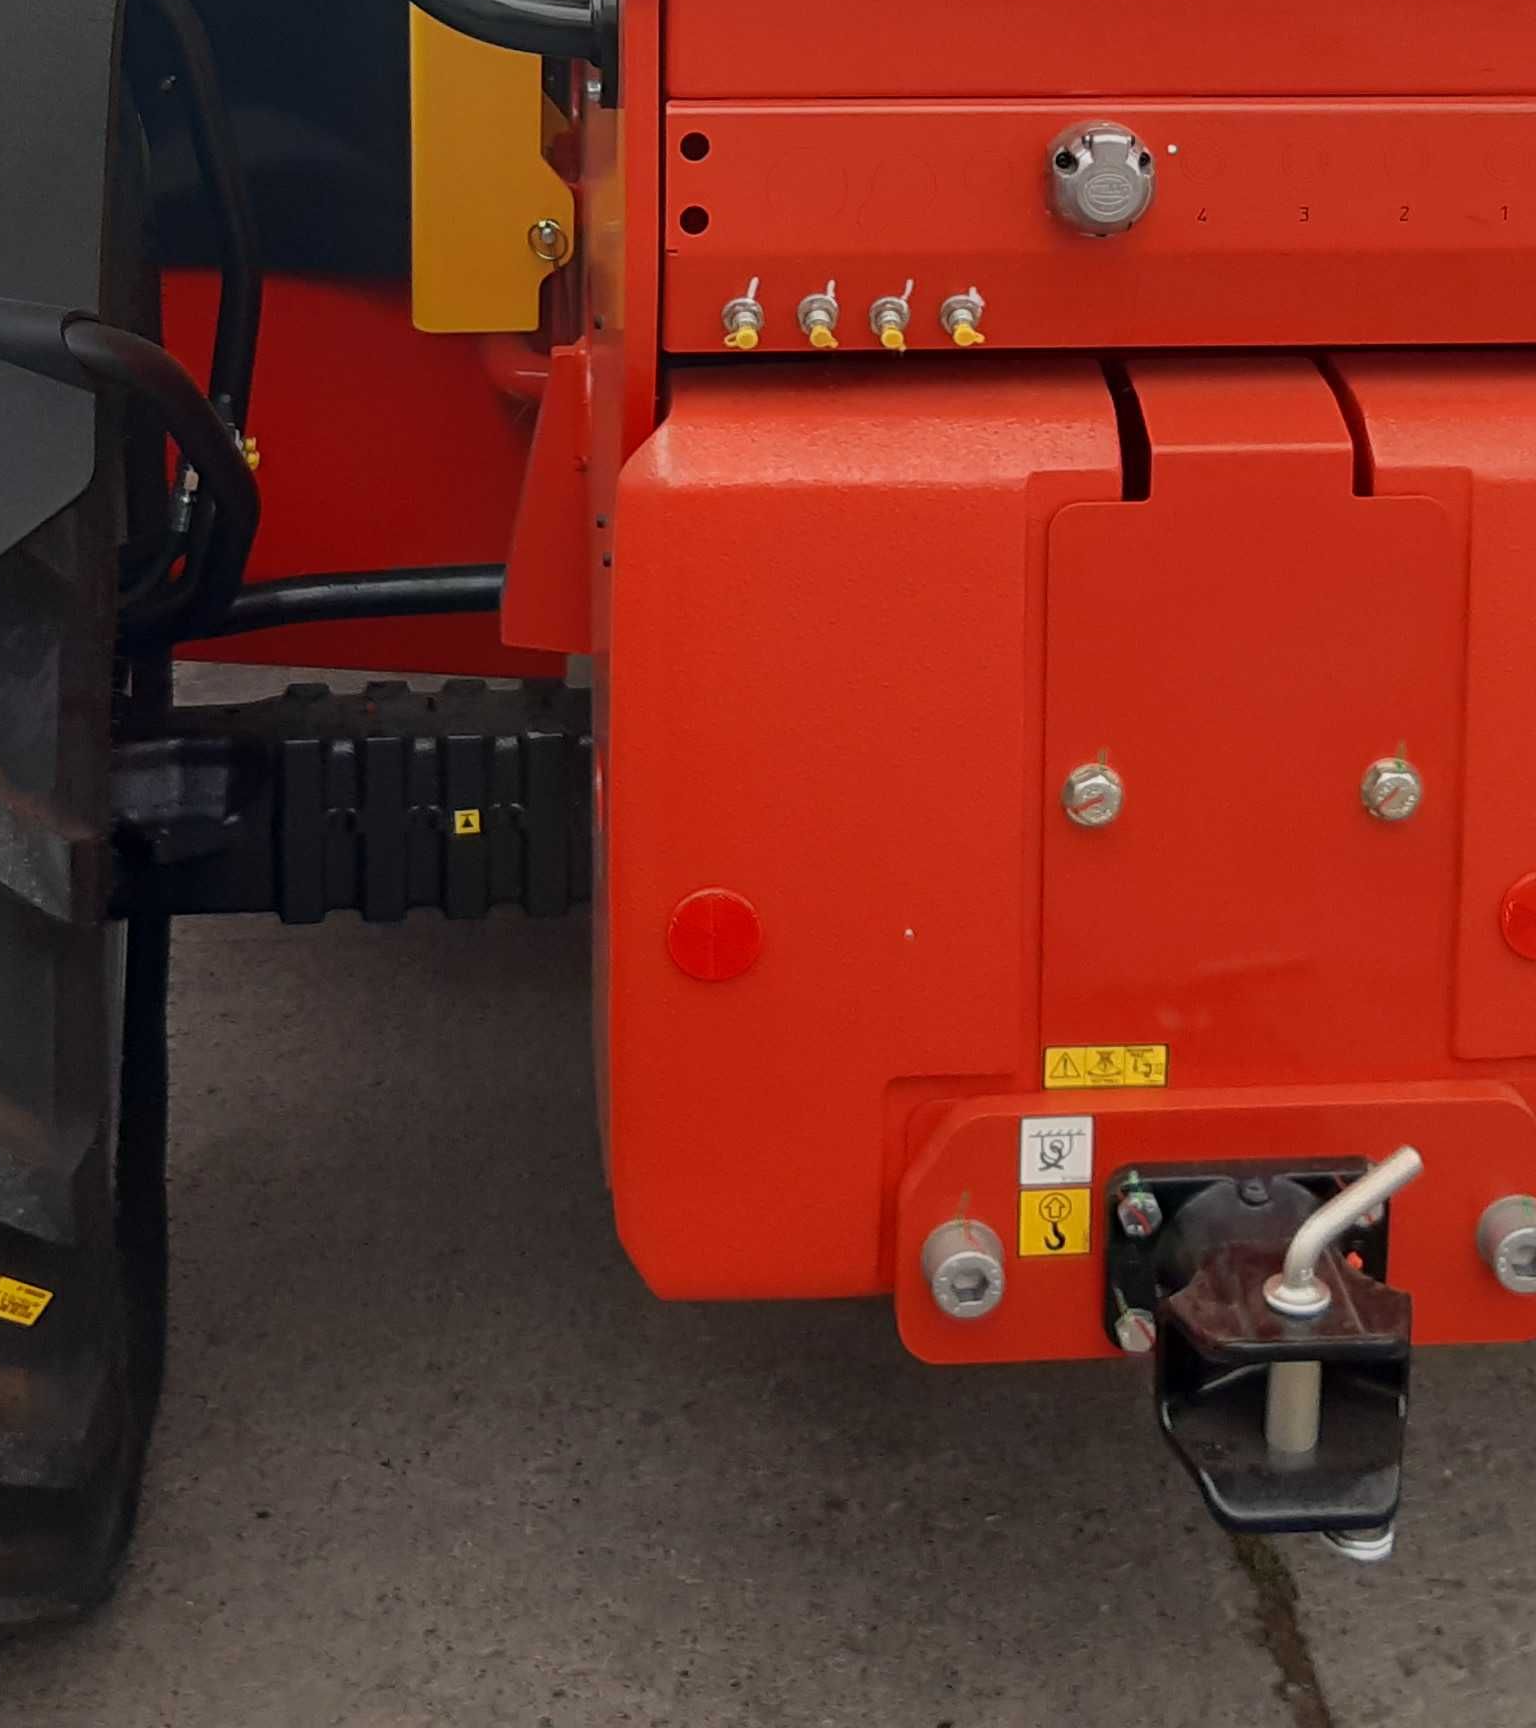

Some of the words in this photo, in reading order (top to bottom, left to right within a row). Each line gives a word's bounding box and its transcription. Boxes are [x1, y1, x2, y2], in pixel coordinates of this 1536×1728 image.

[1197, 207, 1208, 222] 4
[1298, 206, 1310, 222] 3
[1398, 205, 1410, 222] 2
[1500, 205, 1509, 221] 1
